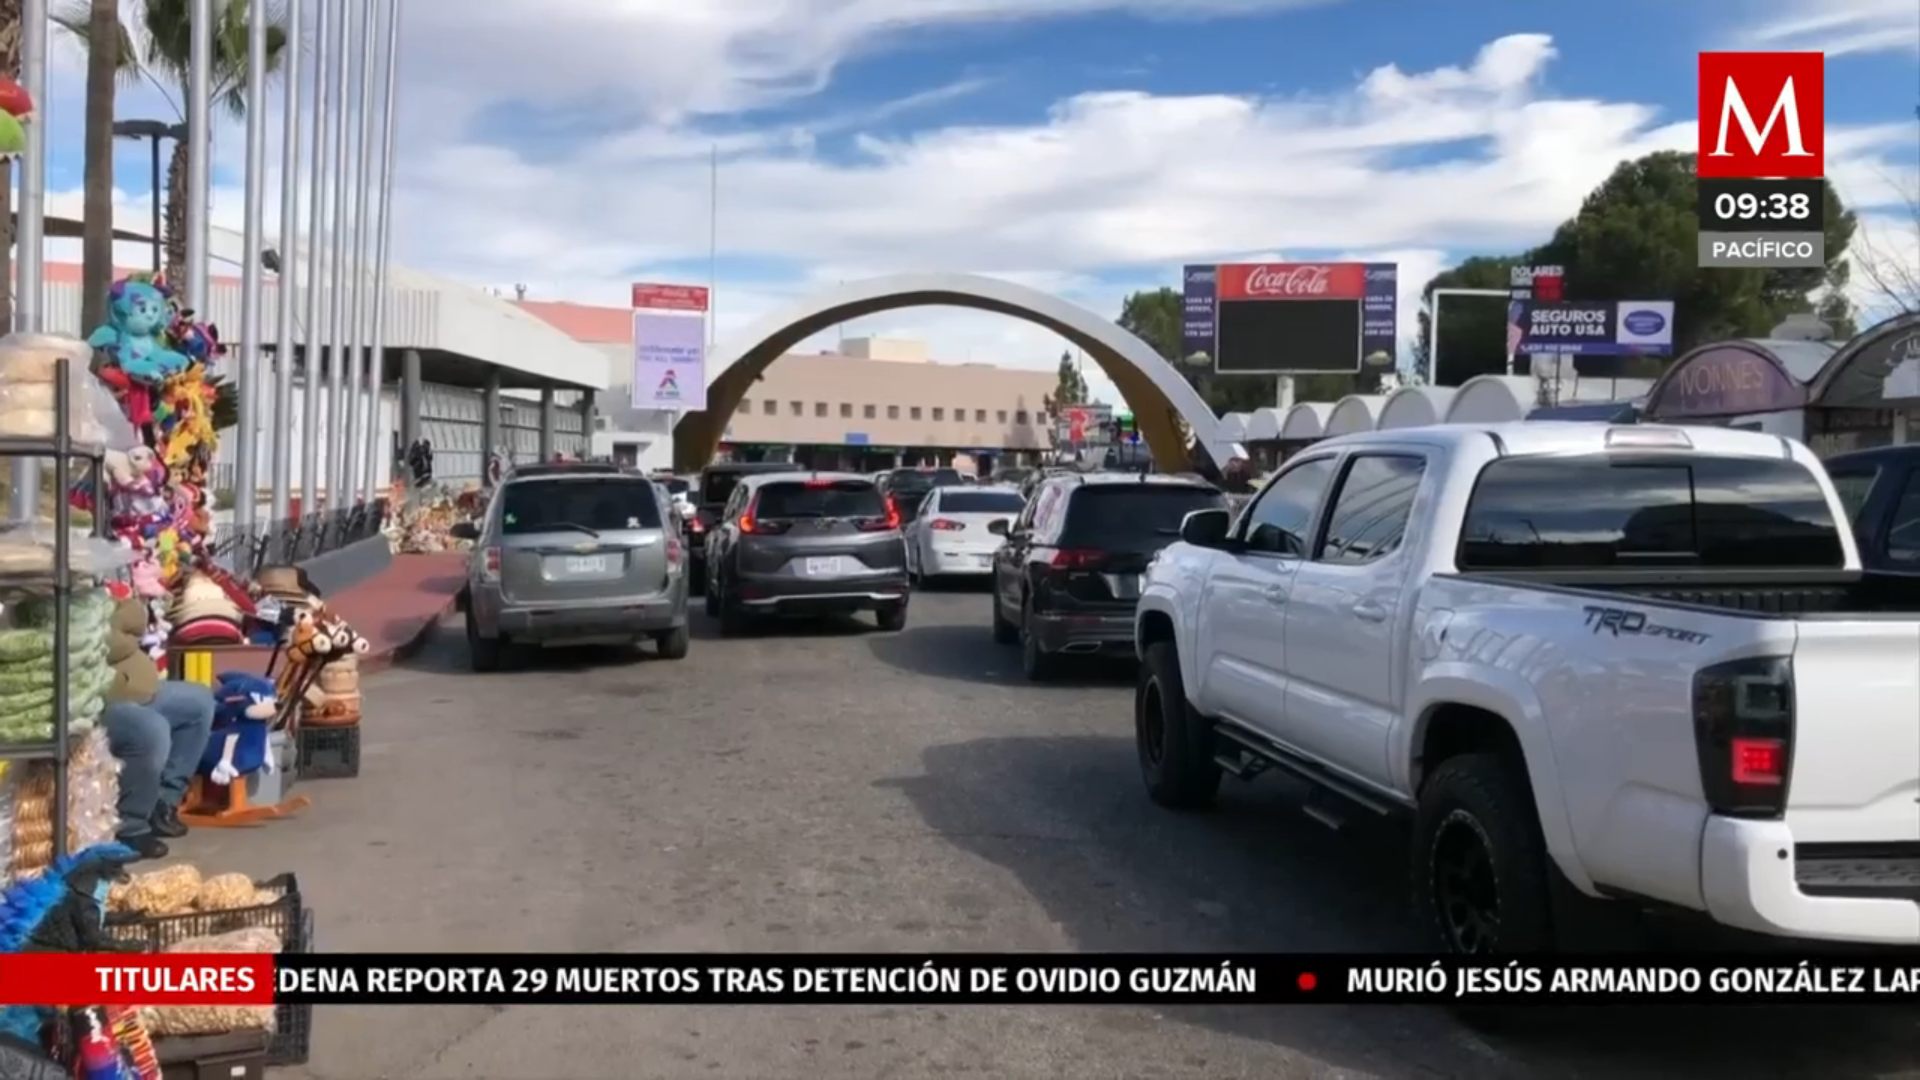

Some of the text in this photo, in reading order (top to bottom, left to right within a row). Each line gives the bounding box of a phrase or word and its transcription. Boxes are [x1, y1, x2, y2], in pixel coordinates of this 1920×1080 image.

[1245, 265, 1331, 295] Coca-Cola
[1531, 309, 1606, 323] SEGUROS
[1529, 324, 1605, 336] AUTO USA
[1583, 605, 1647, 638] TRD
